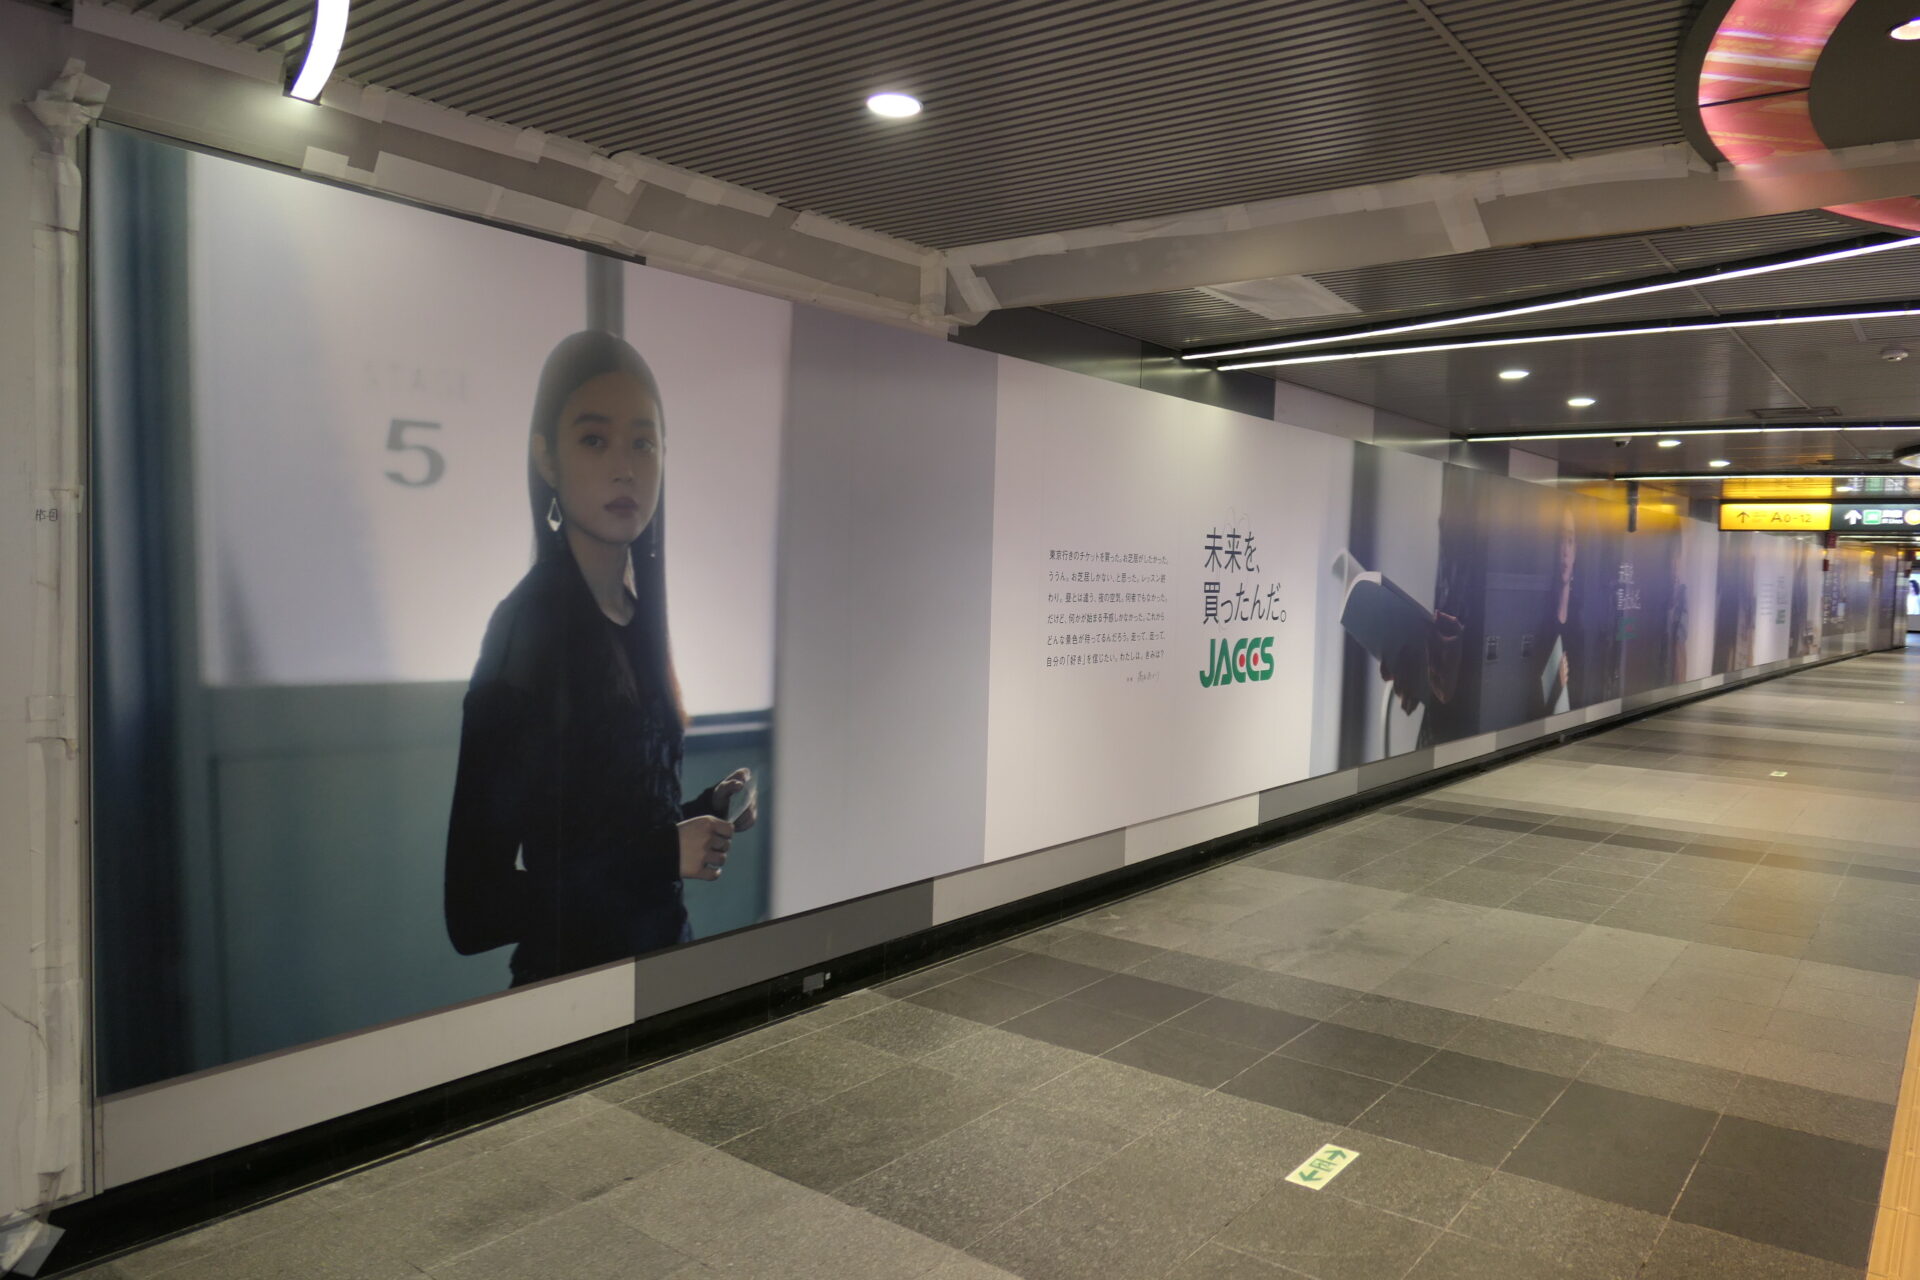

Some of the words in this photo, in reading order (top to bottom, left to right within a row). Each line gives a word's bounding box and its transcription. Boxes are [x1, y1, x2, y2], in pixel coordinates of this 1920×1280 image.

[384, 418, 446, 488] 5
[1204, 527, 1260, 573] 未来を、
[1203, 581, 1287, 625] 買ったんだ。
[1199, 636, 1275, 688] JACCS
